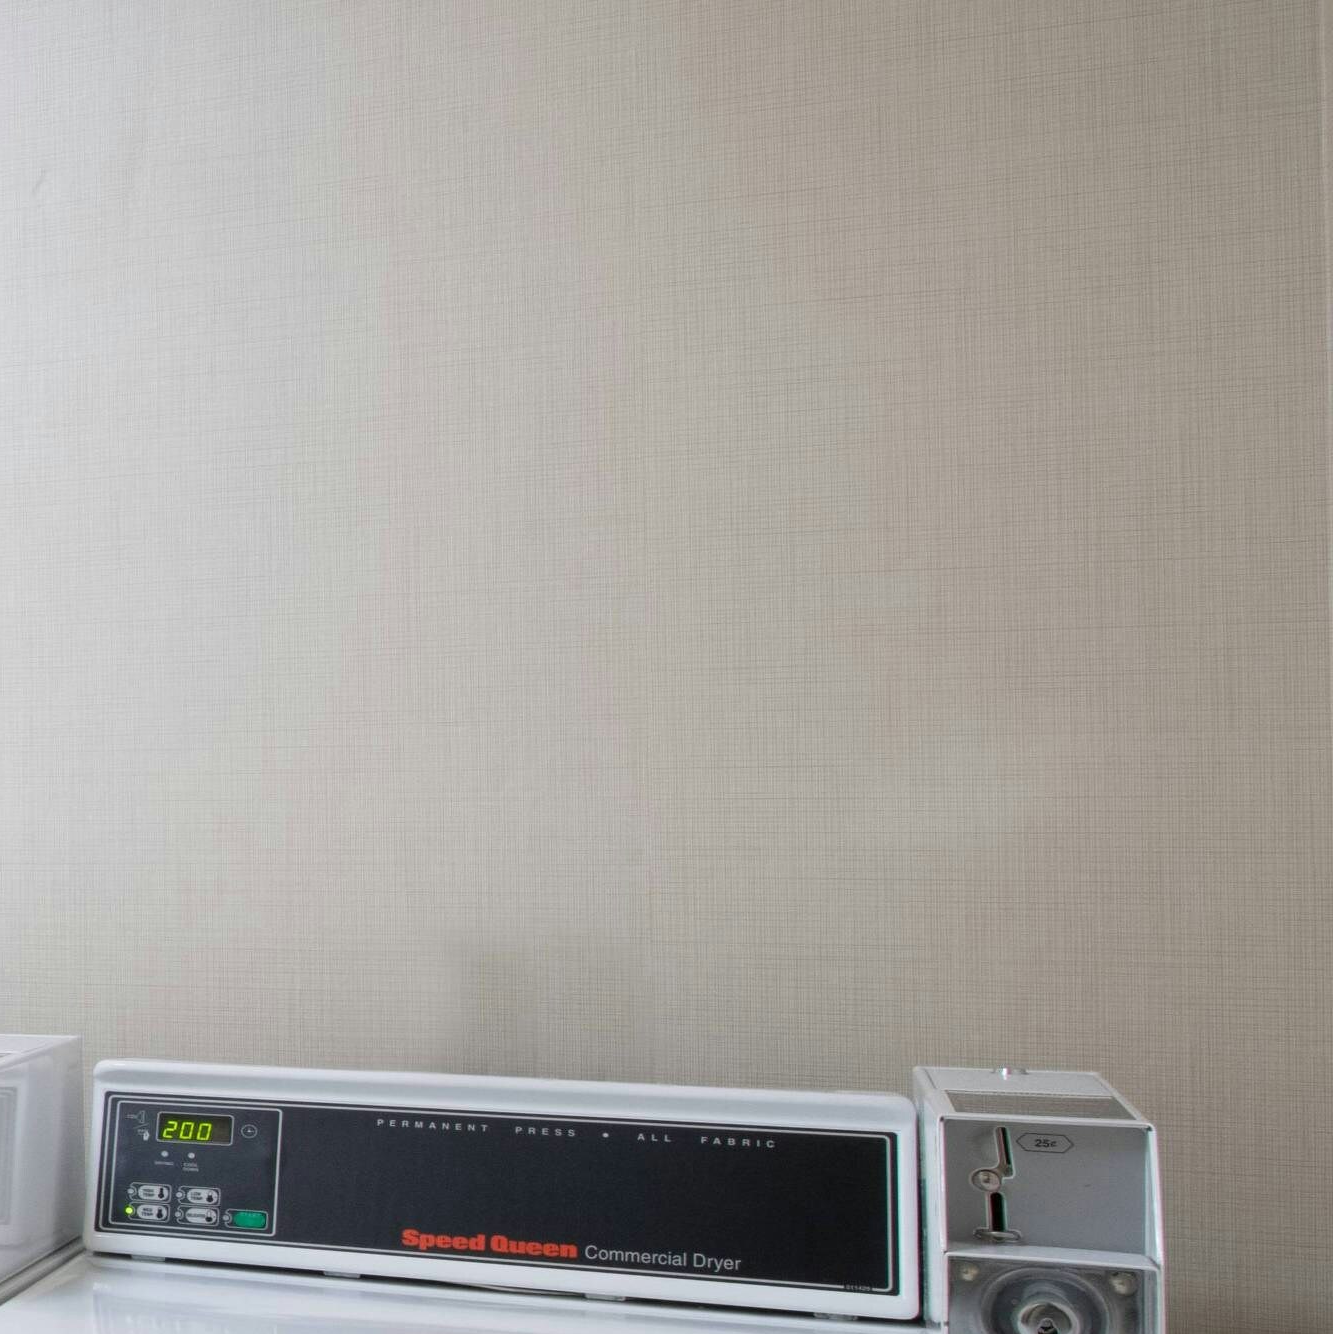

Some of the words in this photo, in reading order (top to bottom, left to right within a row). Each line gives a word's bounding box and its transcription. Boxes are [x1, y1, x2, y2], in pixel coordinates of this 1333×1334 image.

[163, 1121, 212, 1141] 200
[377, 1118, 489, 1132] PERMANENT
[515, 1126, 576, 1137] PRESS
[637, 1133, 671, 1143] ALL
[701, 1136, 776, 1148] FABRIC
[401, 1228, 486, 1252] Speed
[490, 1235, 578, 1259] Queen
[585, 1244, 688, 1267] Commercial
[693, 1254, 741, 1273] Dryer
